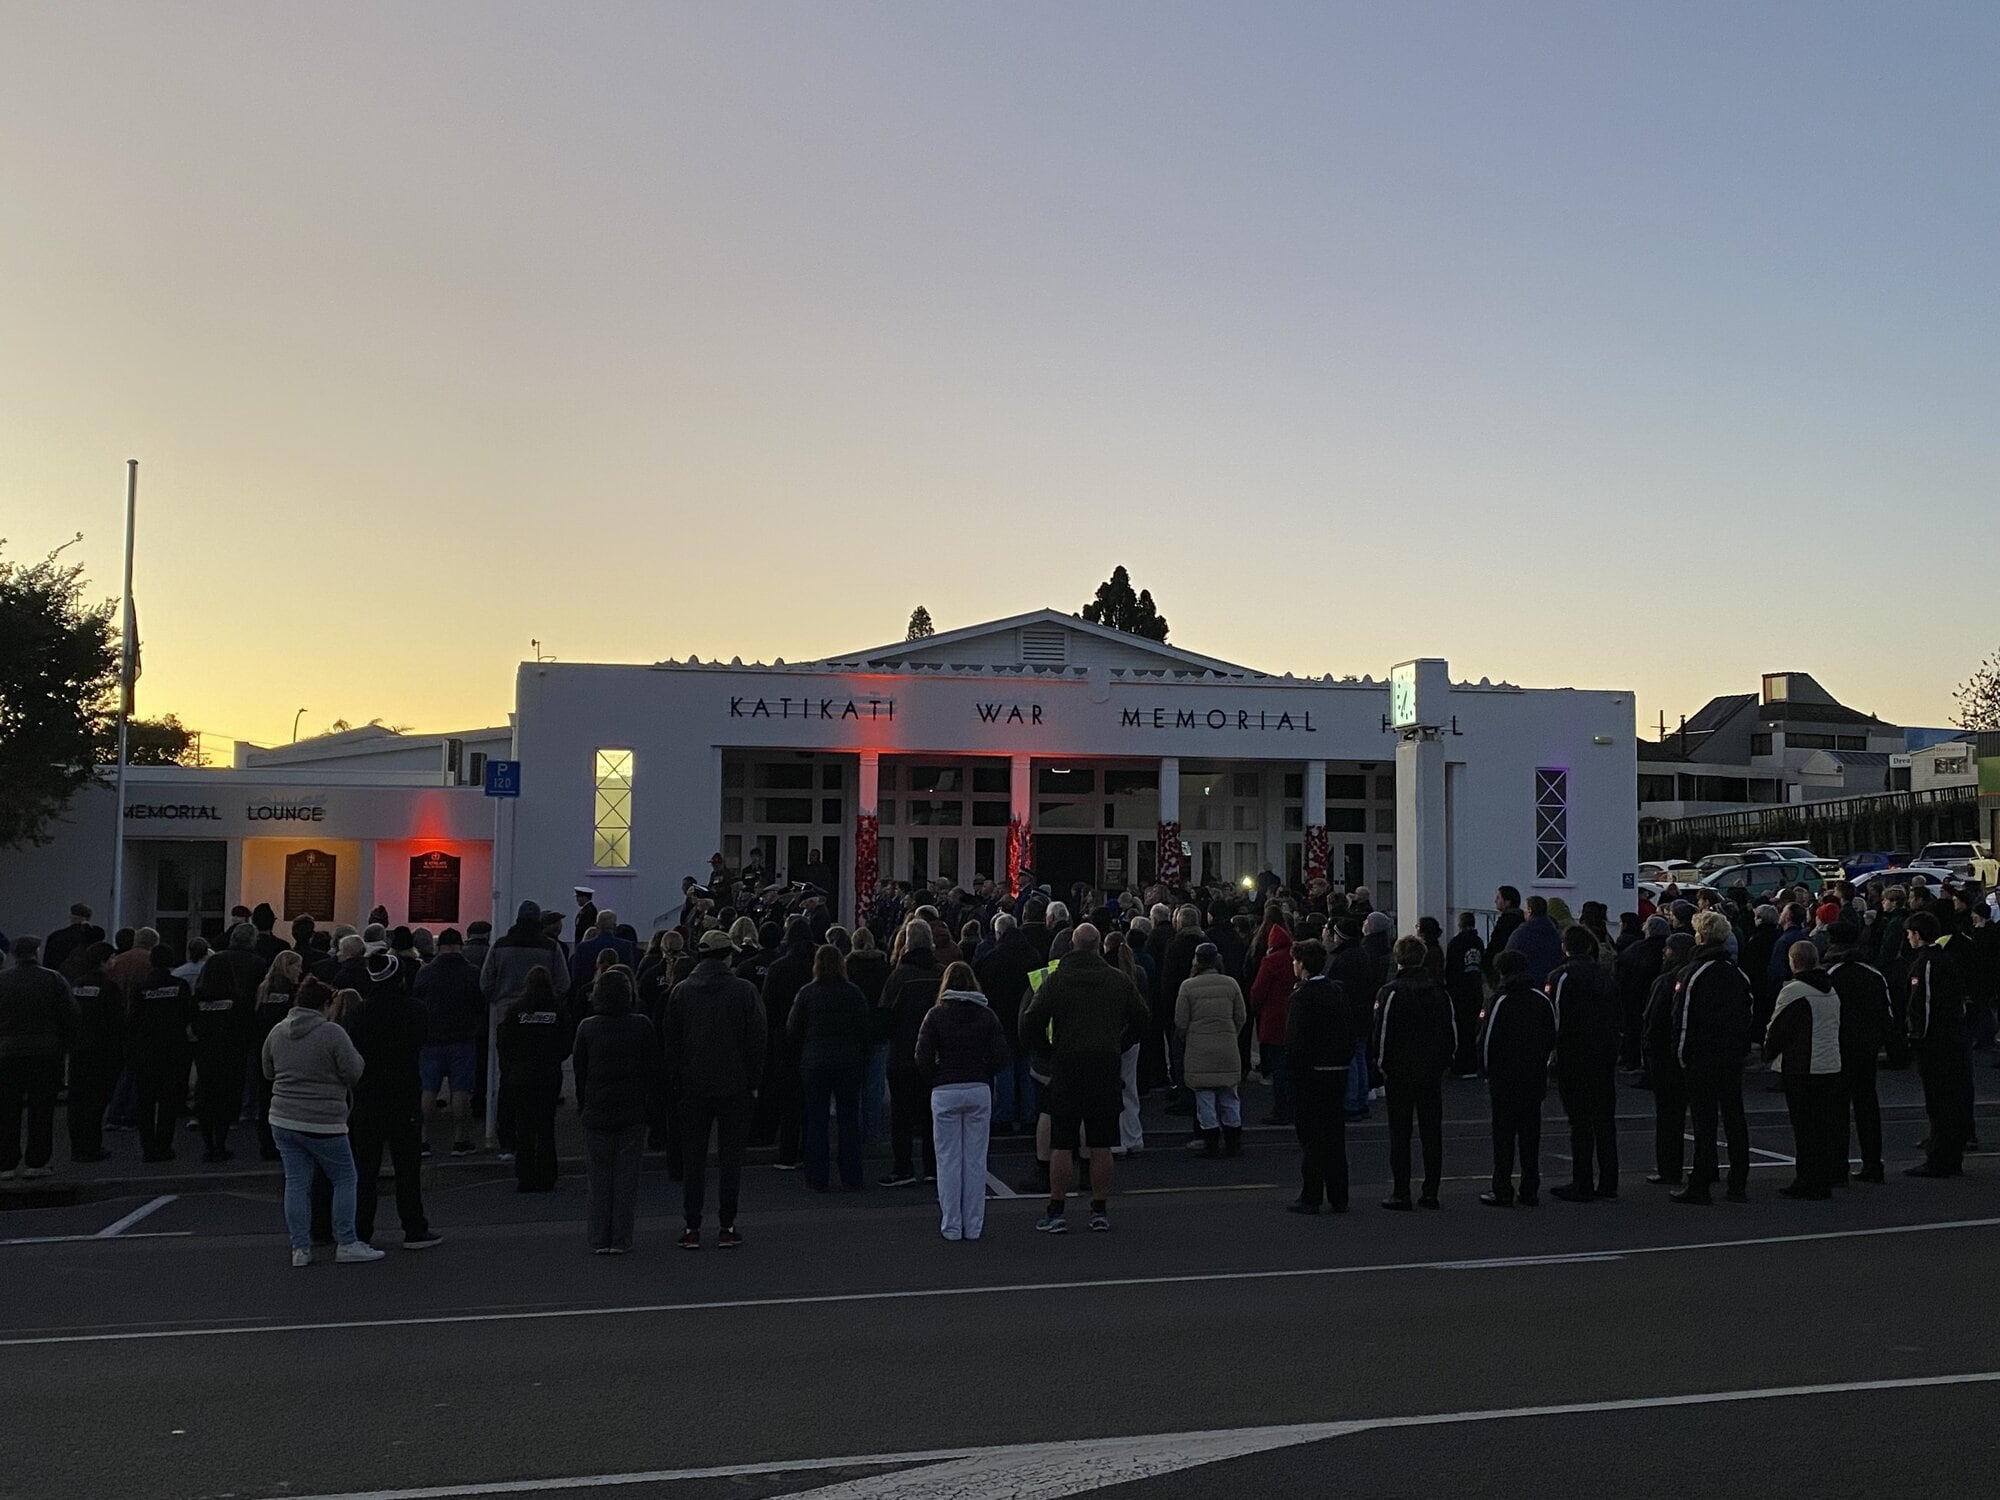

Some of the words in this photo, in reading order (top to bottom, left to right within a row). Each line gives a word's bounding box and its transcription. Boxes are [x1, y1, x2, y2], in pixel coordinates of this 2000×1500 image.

[729, 695, 894, 721] KATIKATI
[975, 703, 1044, 725] WAR
[1122, 707, 1317, 732] MEMORIAL
[1382, 713, 1463, 735] HL
[497, 763, 508, 776] P
[494, 777, 511, 788] 120
[247, 805, 325, 821] LOUNGE
